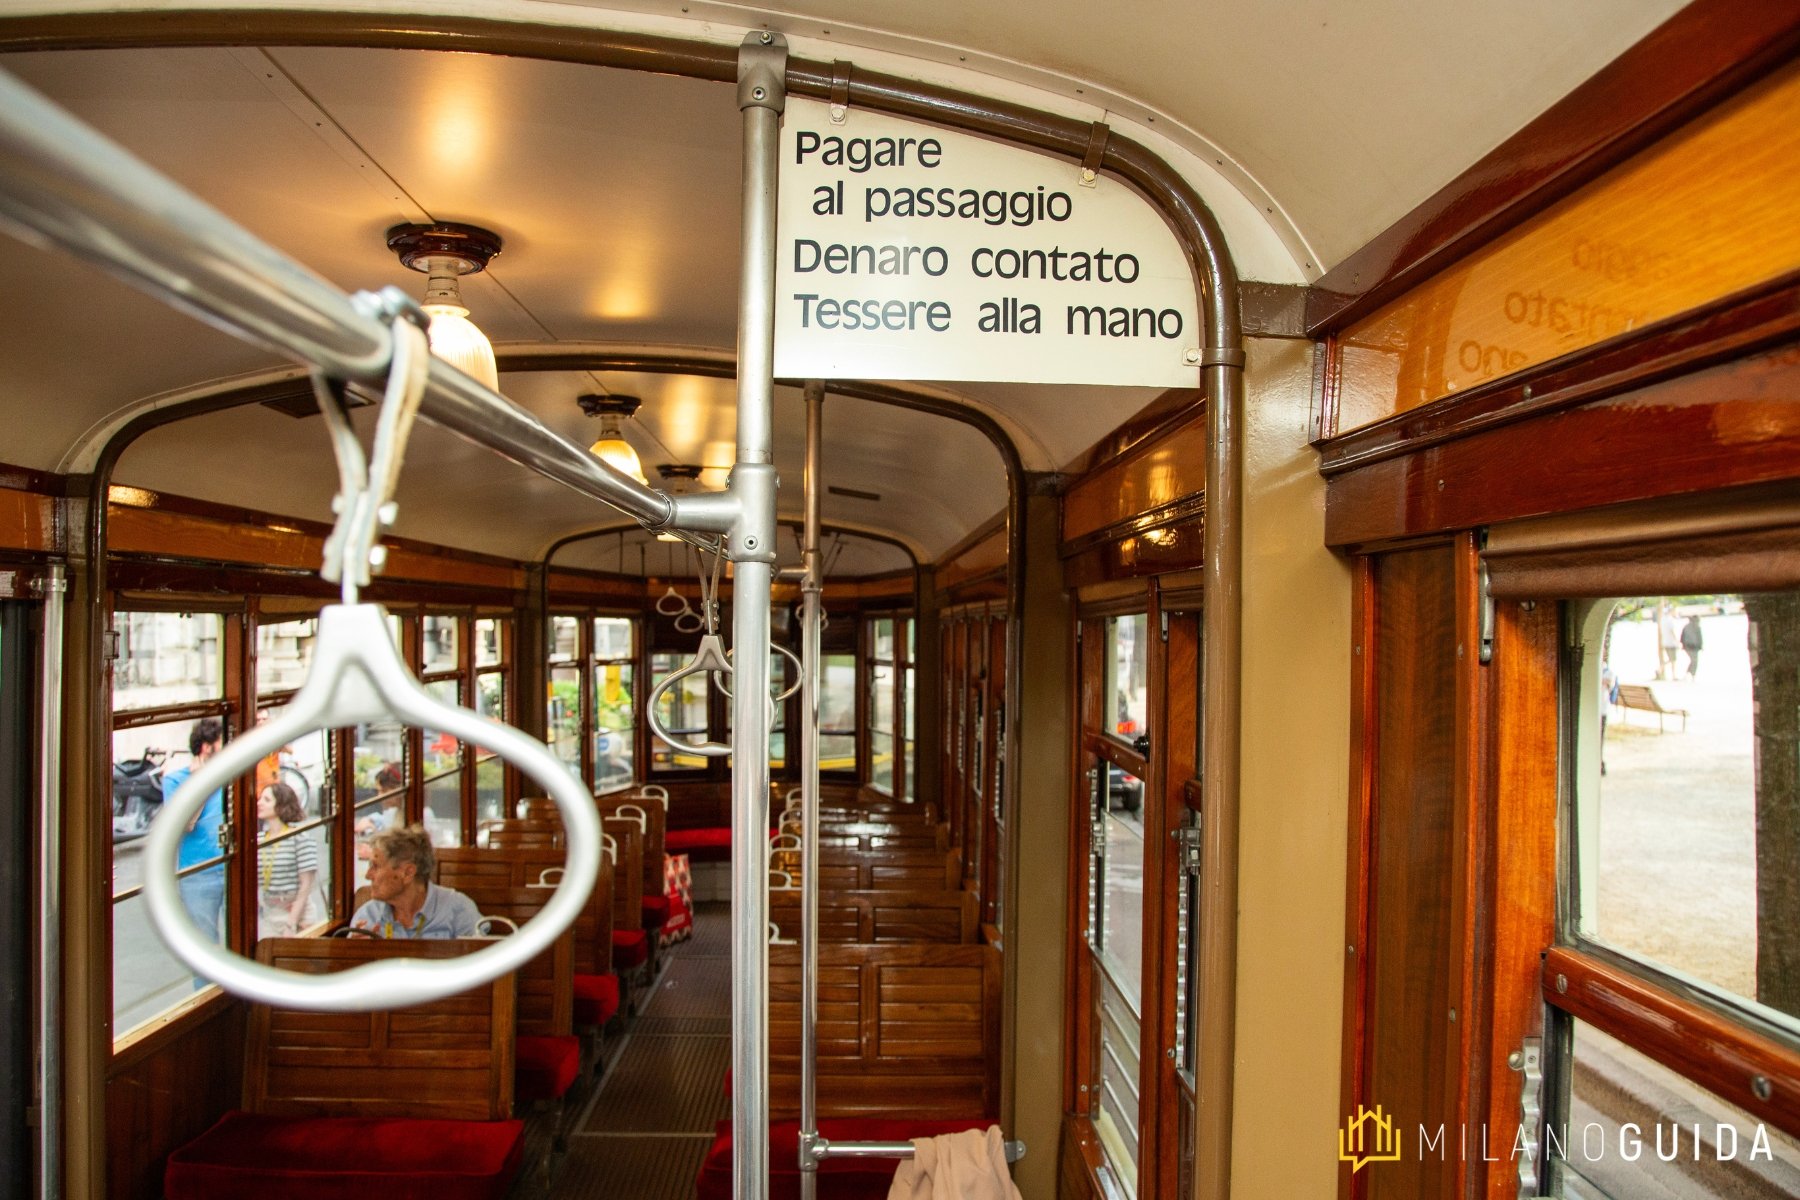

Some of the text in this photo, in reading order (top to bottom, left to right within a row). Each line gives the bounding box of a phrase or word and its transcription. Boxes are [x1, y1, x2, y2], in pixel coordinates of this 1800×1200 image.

[796, 131, 942, 173] Pagare
[812, 180, 1073, 227] al passaggio
[794, 238, 1140, 284] Denaro contato
[793, 293, 1184, 340] Tessere alla mano
